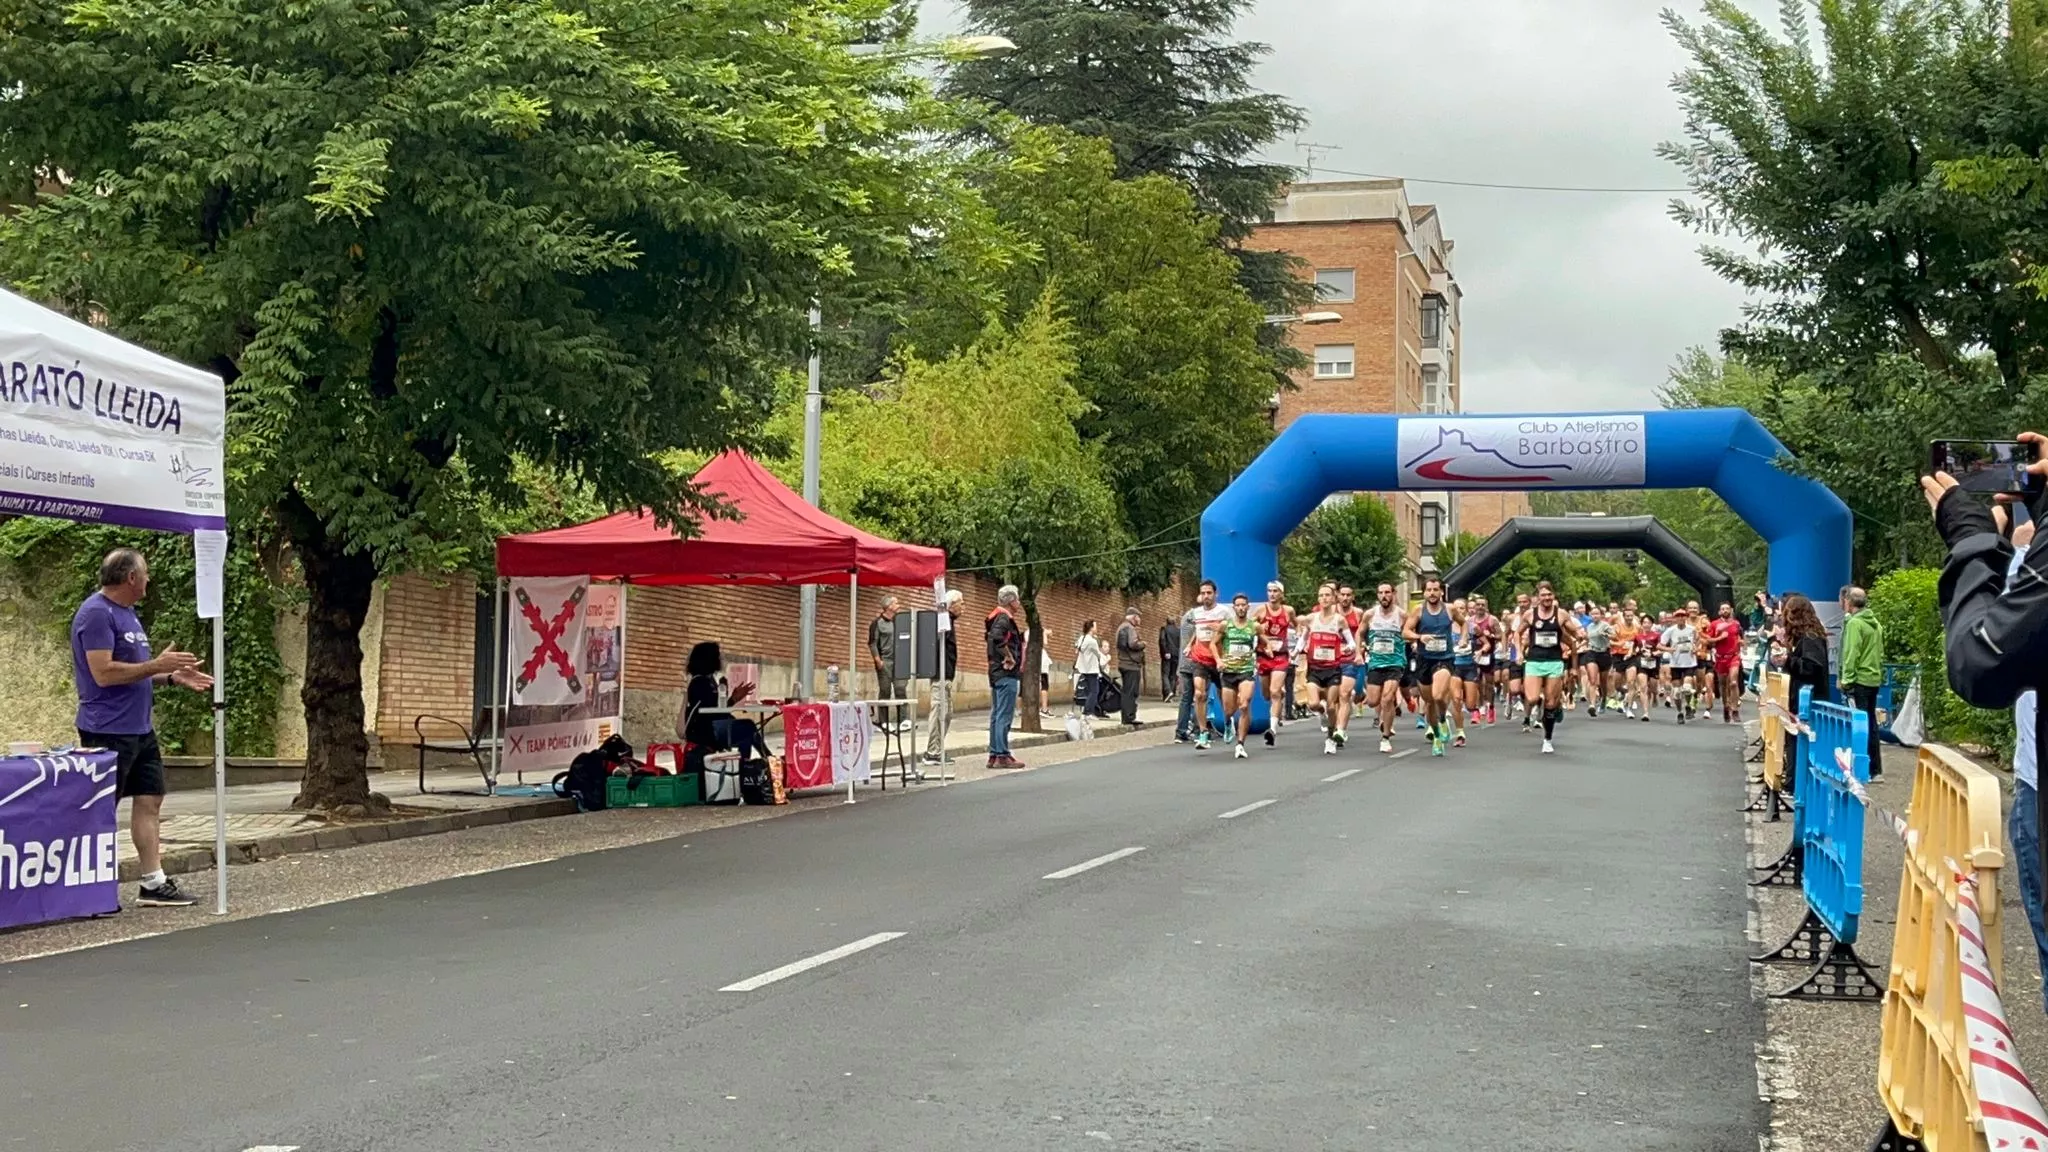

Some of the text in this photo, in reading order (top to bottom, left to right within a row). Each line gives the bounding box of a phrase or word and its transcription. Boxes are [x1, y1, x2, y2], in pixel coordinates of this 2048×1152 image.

[95, 378, 181, 434] LLEIDA
[1518, 420, 1638, 433] Club Atletismo
[119, 448, 144, 461] Cursa
[1519, 437, 1638, 455] Barbastro
[26, 466, 57, 482] Curses
[59, 471, 95, 488] Infantils
[34, 501, 42, 511] A
[43, 501, 104, 518] PARTICIPAR!!
[527, 738, 546, 753] TEAM
